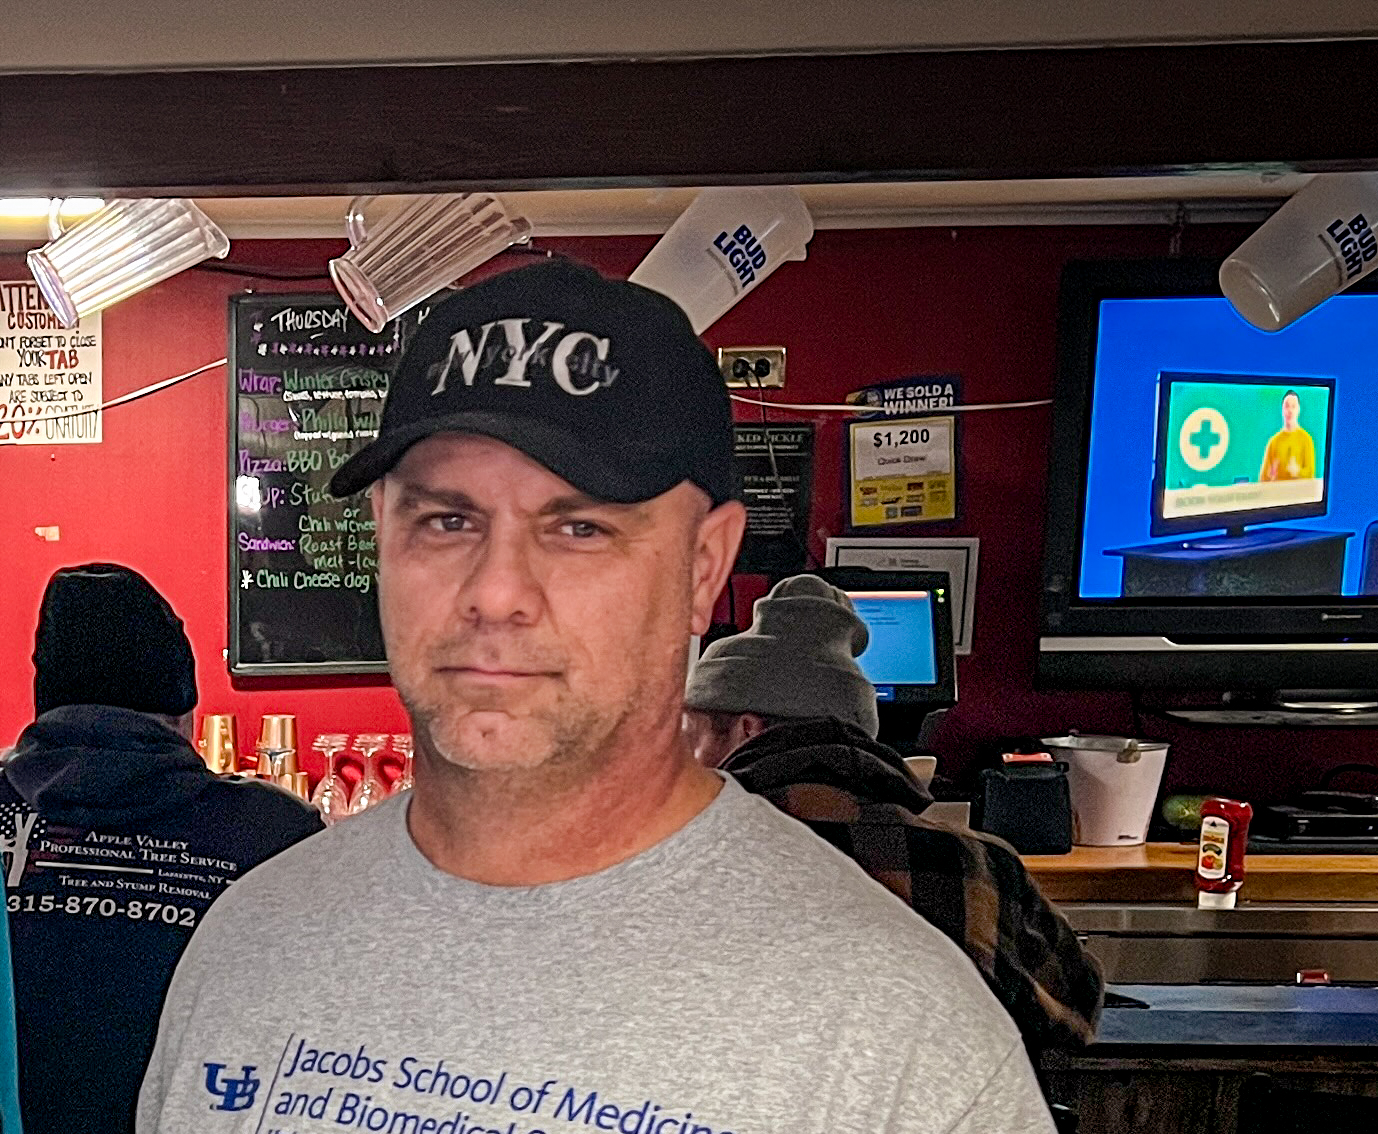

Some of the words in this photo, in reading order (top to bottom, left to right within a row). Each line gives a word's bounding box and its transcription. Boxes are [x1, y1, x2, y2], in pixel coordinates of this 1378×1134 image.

[732, 224, 767, 269] BUD
[1326, 218, 1363, 280] LIGHT
[1347, 213, 1378, 262] BUD
[713, 231, 755, 288] LIGHT
[7, 311, 80, 334] CUSTOME!
[270, 305, 350, 333] THURSDAY
[19, 335, 53, 349] FORGET
[55, 336, 67, 348] TO
[70, 334, 97, 348] CLOSE
[16, 348, 47, 368] YOUR
[45, 349, 80, 369] TAB
[430, 318, 611, 396] NYC
[17, 373, 40, 386] TABS
[44, 373, 66, 385] LEFT
[68, 371, 92, 385] OPEN
[238, 367, 282, 393] Wrap:
[283, 368, 336, 391] Winter
[339, 368, 391, 392] Crispy
[8, 389, 27, 404] ARE
[30, 390, 68, 403] SUBJECT
[71, 389, 84, 401] TO
[884, 387, 905, 400] WE
[906, 384, 942, 399] SOLD
[943, 383, 954, 396] A
[883, 396, 954, 416] WINNER!
[302, 408, 348, 433] Philly
[873, 428, 930, 448] $1,200
[238, 449, 287, 473] Pizza:
[298, 515, 332, 533] Chili
[343, 508, 361, 518] or
[299, 533, 344, 555] Roast
[256, 569, 289, 588] Chili
[293, 570, 341, 589] Cheese
[343, 569, 371, 593] dog
[85, 831, 132, 846] APPLE
[136, 834, 189, 850] VALLEY
[40, 840, 136, 860] PROFESSIONAL
[139, 848, 177, 863] TREE
[180, 852, 238, 872] SERVICE
[58, 875, 89, 887] TREE
[91, 879, 114, 888] AND
[116, 879, 156, 892] STUMP
[158, 882, 213, 900] REMOVAL
[208, 875, 226, 884] NY
[6, 895, 197, 928] 315-870-8702
[283, 1038, 388, 1083] Jacobs
[392, 1056, 508, 1105] School
[509, 1080, 559, 1114] of
[274, 1087, 335, 1120] and
